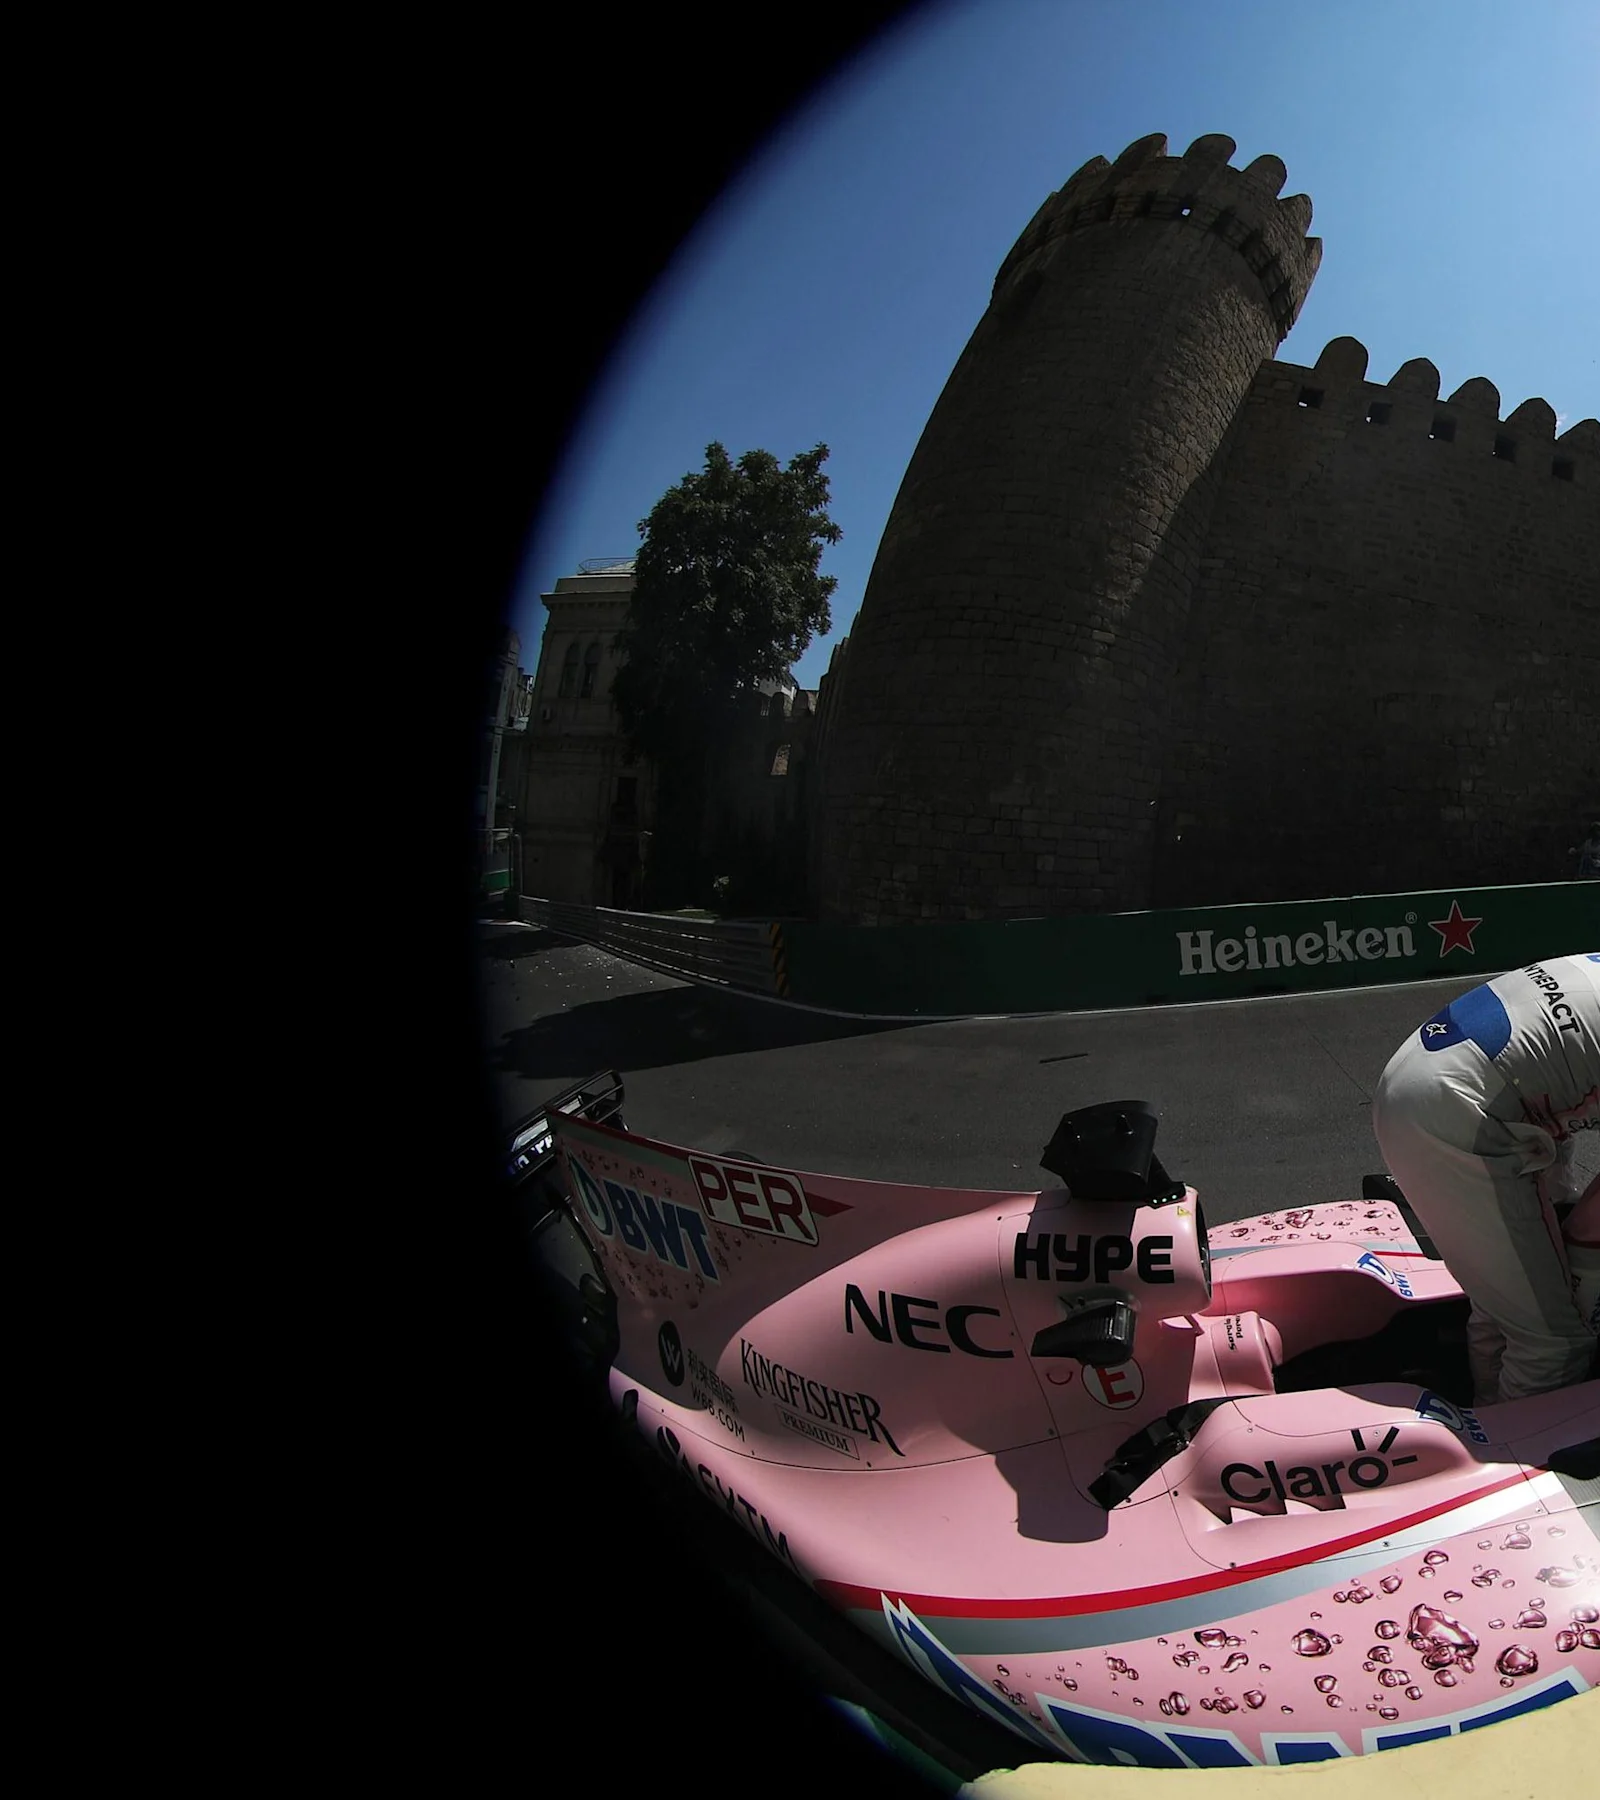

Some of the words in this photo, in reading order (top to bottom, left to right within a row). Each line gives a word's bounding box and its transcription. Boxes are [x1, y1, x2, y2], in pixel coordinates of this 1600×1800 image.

[604, 1179, 719, 1281] BWT
[692, 1158, 814, 1241] PER
[1013, 1232, 1175, 1284] HYPE
[845, 1284, 1014, 1358] NEC
[741, 1338, 905, 1457] KINGFISHER
[1098, 1364, 1136, 1405] E
[782, 1411, 850, 1453] PREMIUM
[1221, 1450, 1390, 1504] Claro
